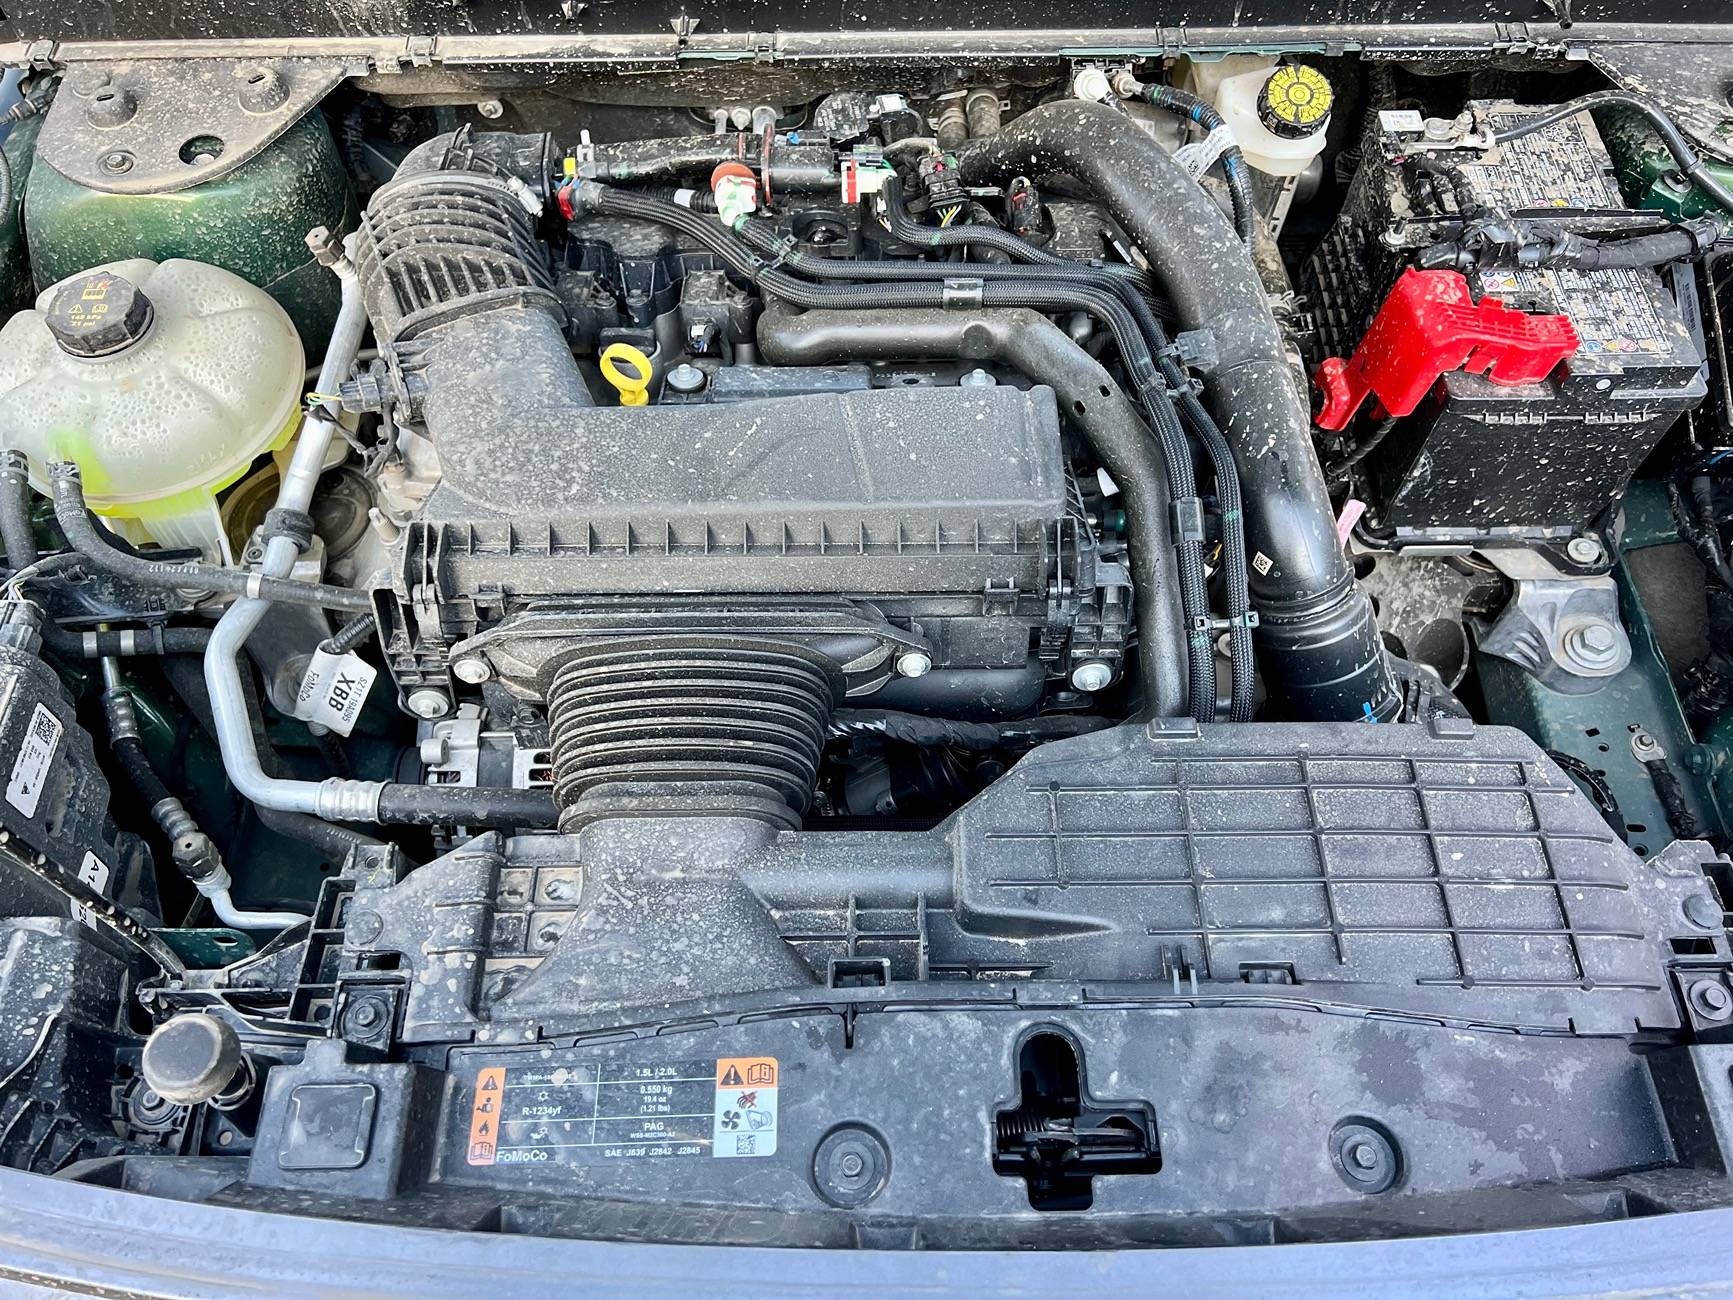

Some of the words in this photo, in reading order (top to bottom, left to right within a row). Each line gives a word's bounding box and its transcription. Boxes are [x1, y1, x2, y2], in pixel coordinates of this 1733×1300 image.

[328, 671, 356, 712] XBB
[635, 1068, 653, 1077] 1.5L
[658, 1067, 678, 1076] 2.0L
[640, 1085, 661, 1094] 0.550
[662, 1084, 673, 1095] kg
[521, 1105, 563, 1117] R-1234yf
[644, 1122, 664, 1131] PAG
[495, 1149, 548, 1162] FoMoCo
[604, 1148, 622, 1157] SAE
[649, 1147, 673, 1156] J2842
[677, 1146, 701, 1155] J2845
